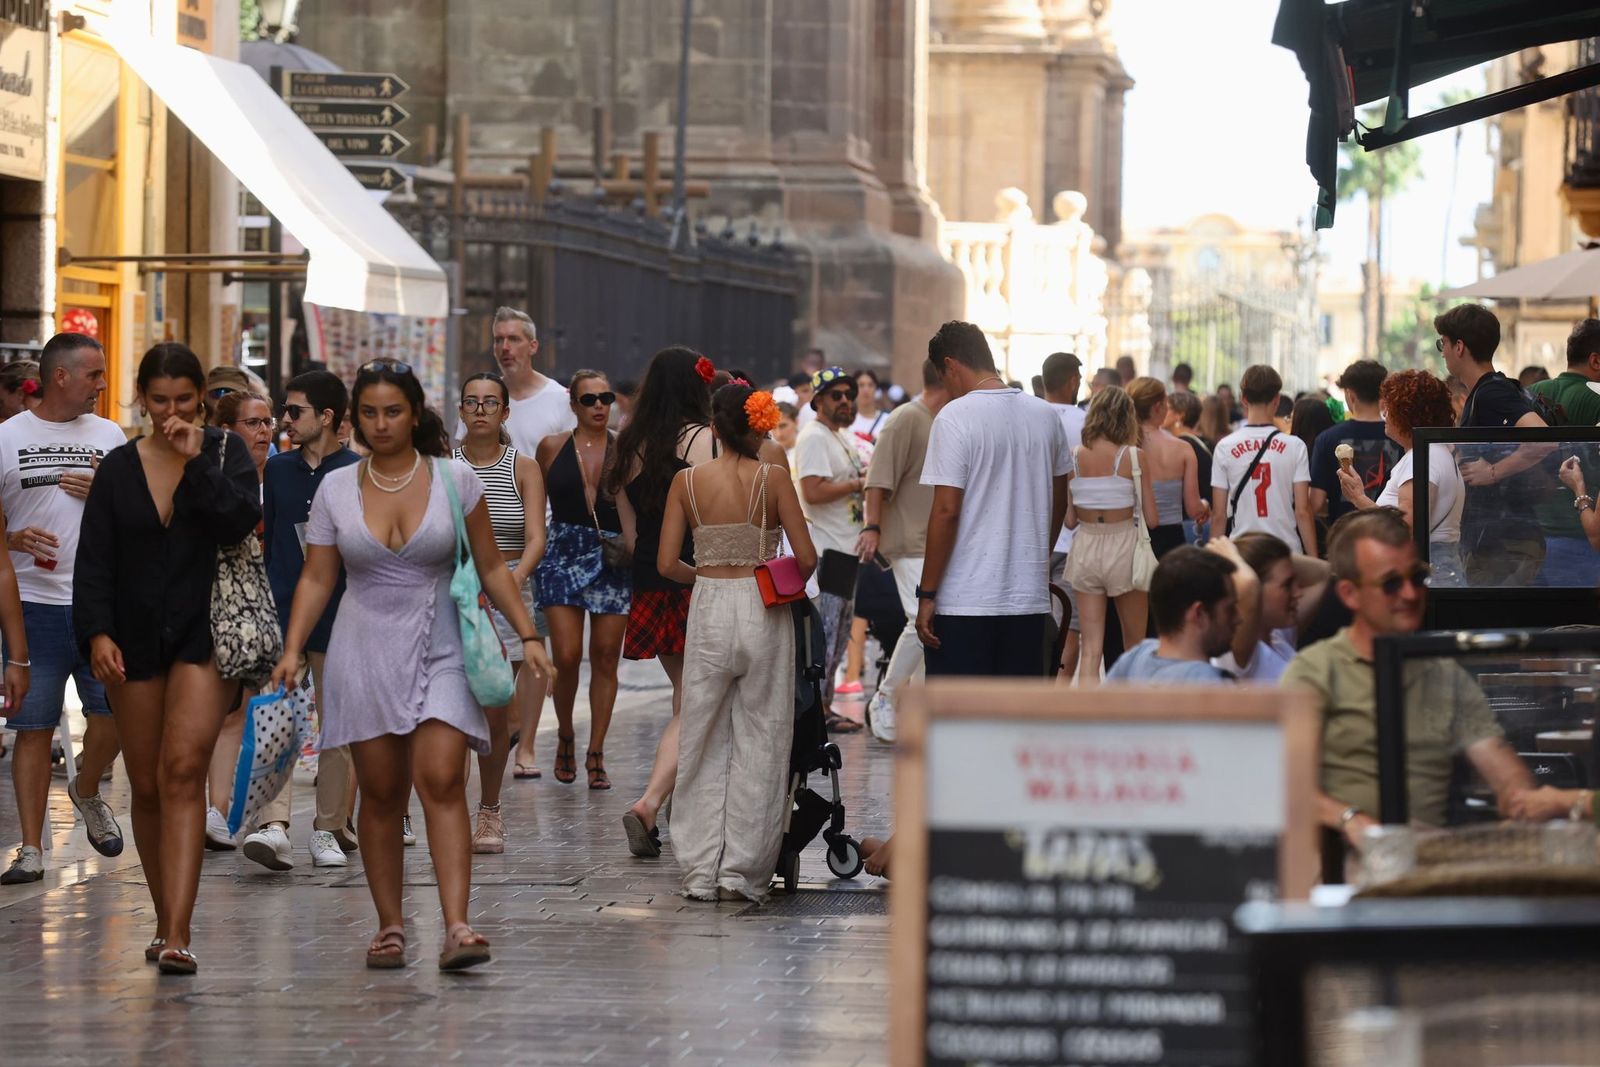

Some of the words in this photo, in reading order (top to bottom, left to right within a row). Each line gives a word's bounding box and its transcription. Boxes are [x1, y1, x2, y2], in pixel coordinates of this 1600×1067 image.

[346, 138, 369, 150] VINO
[26, 443, 96, 454] G-STAR
[1251, 462, 1272, 517] 7
